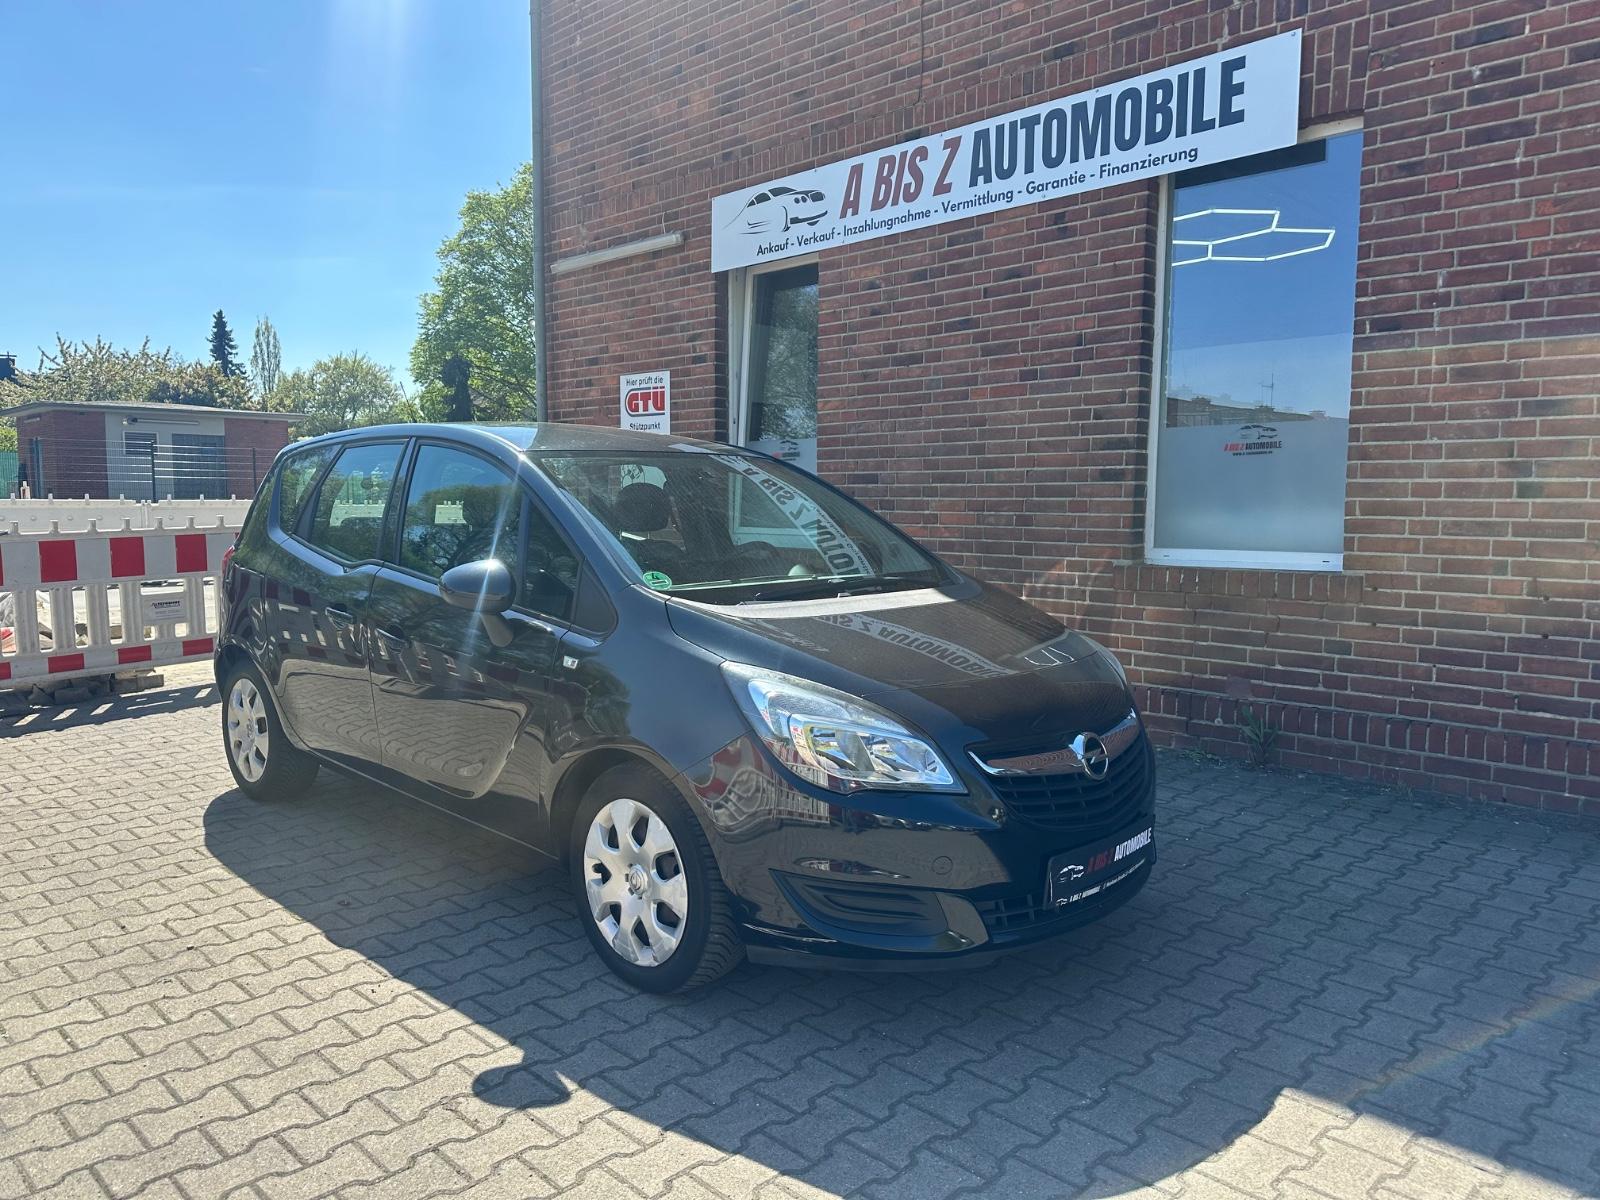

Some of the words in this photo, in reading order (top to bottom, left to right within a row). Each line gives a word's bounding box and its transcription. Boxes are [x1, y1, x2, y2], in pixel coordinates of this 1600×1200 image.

[839, 163, 864, 219] A
[870, 145, 928, 212] BIS
[932, 135, 962, 197] Z
[969, 55, 1247, 188] AUTOMOBILE
[756, 240, 789, 256] Ankauf
[796, 227, 836, 247] Verkauf
[843, 209, 931, 237] Inzahlungnahme
[941, 190, 1014, 213] Vermittlung
[1026, 170, 1086, 195] Garantie
[1099, 147, 1199, 179] Finanzierung
[626, 378, 637, 386] Hier
[639, 376, 652, 386] prüft
[654, 376, 663, 384] die
[627, 385, 666, 413] GTÜ
[629, 421, 661, 431] Stützpunkt
[1246, 440, 1282, 450] AUTOMOBILE
[1114, 827, 1152, 861] AUTOMOBILE
